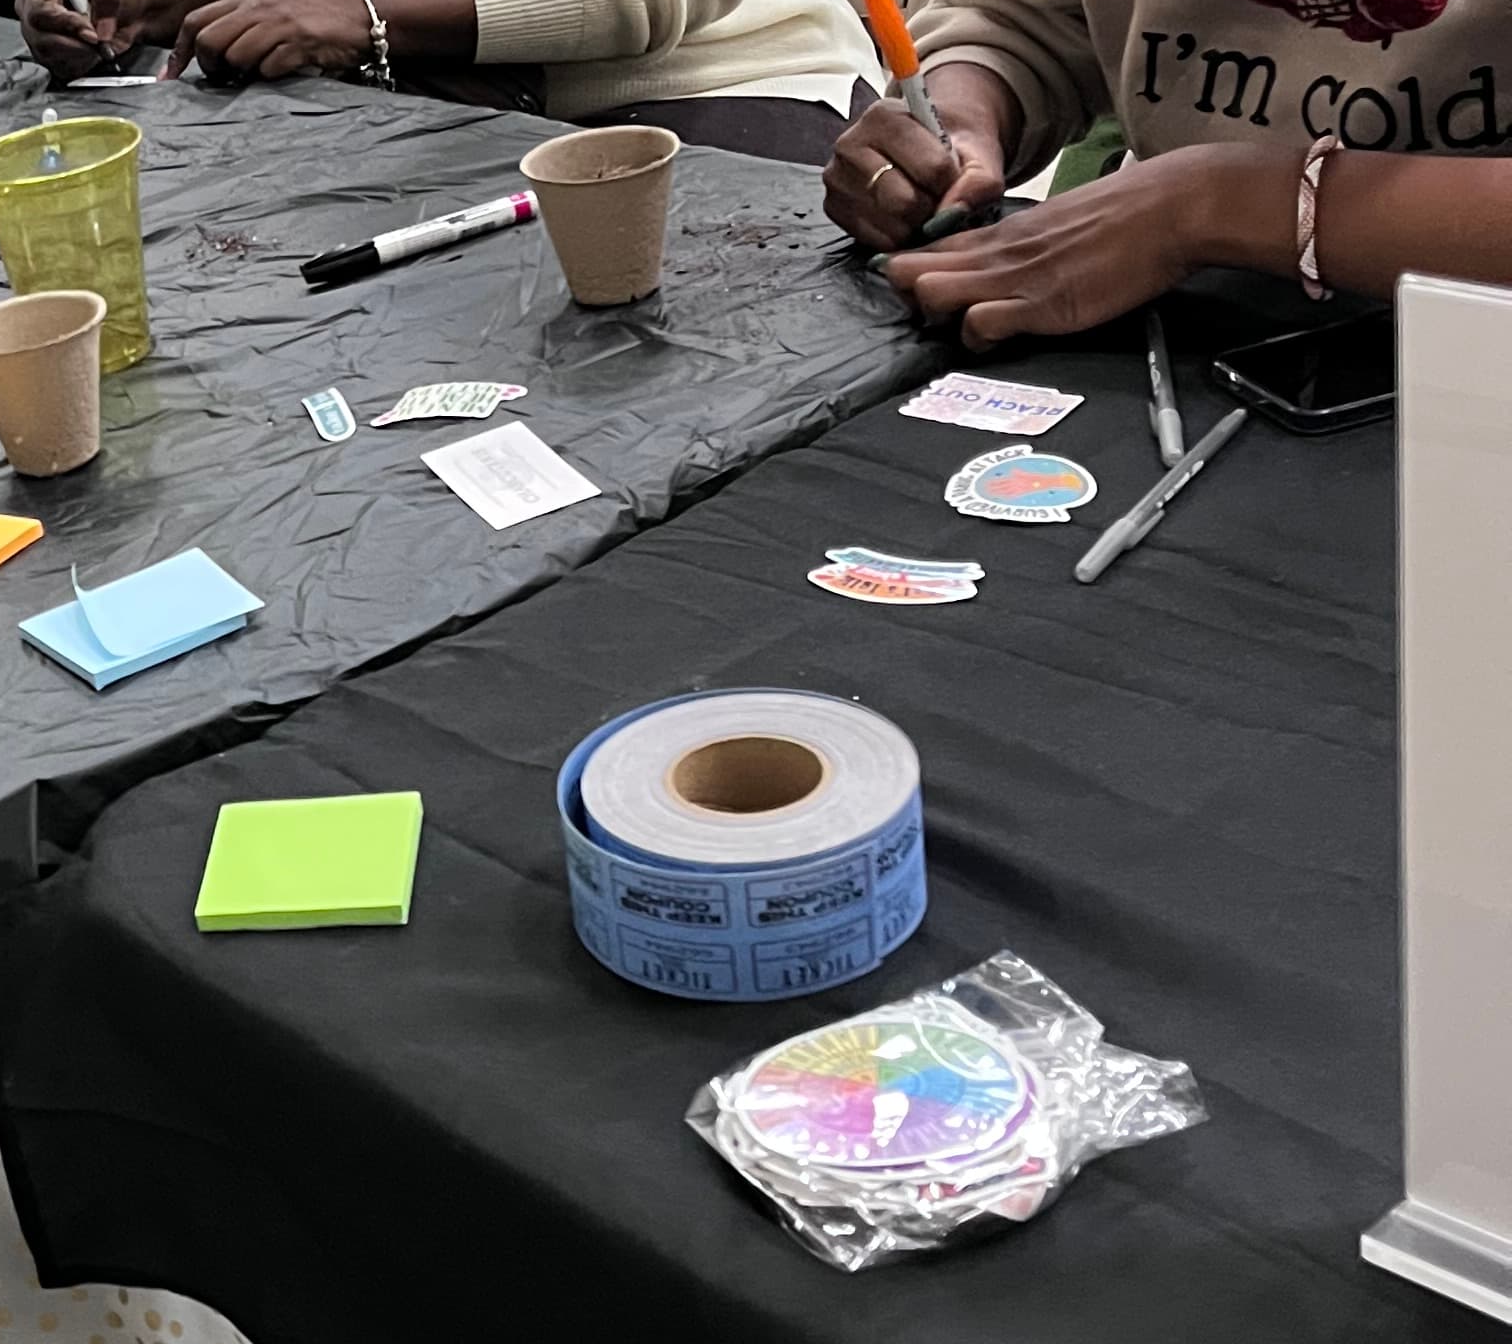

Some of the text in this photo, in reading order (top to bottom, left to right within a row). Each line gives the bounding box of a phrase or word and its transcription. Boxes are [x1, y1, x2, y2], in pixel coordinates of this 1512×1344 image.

[1136, 31, 1277, 127] I'm
[932, 386, 1066, 418] REACH OUT
[619, 895, 722, 925] KEEP THIS
[624, 886, 710, 913] COUPON
[758, 887, 864, 925] KEEP THIS
[764, 879, 855, 910] COUPON
[641, 959, 712, 991] TICKET
[778, 952, 856, 988] TICKET
